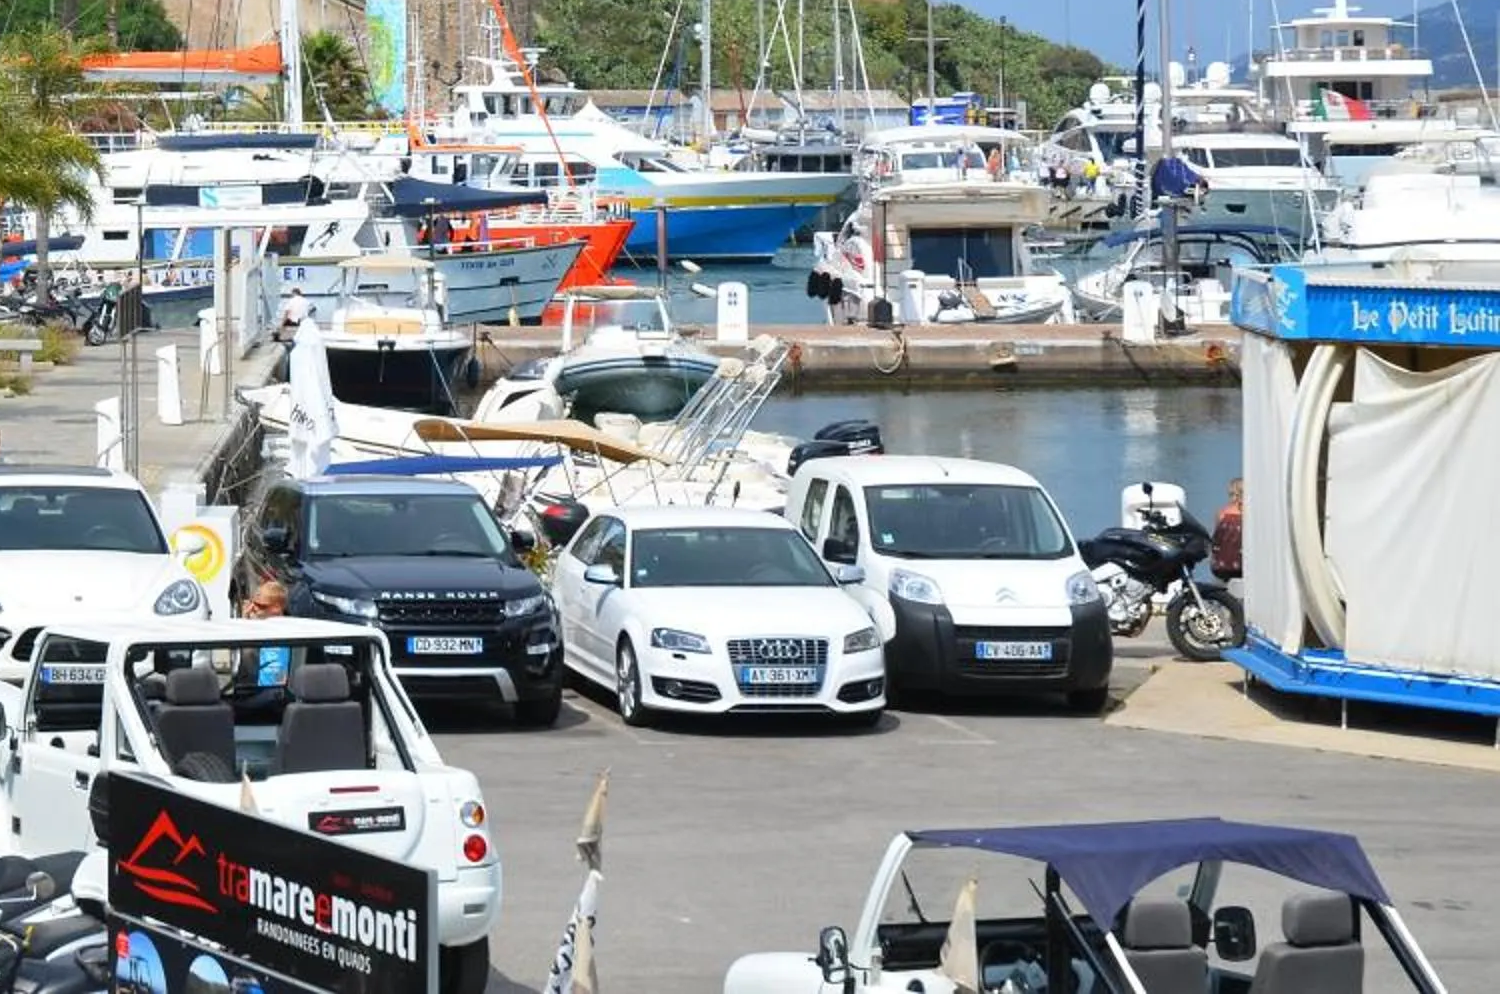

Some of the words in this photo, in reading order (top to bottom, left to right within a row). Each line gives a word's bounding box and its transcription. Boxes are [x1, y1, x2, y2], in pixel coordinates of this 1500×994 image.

[1351, 300, 1379, 331] Le
[1388, 299, 1440, 334] Petit
[381, 591, 436, 599] RANGE
[445, 591, 500, 599] ROVER
[322, 941, 336, 959] EN
[337, 947, 373, 976] QUADS
